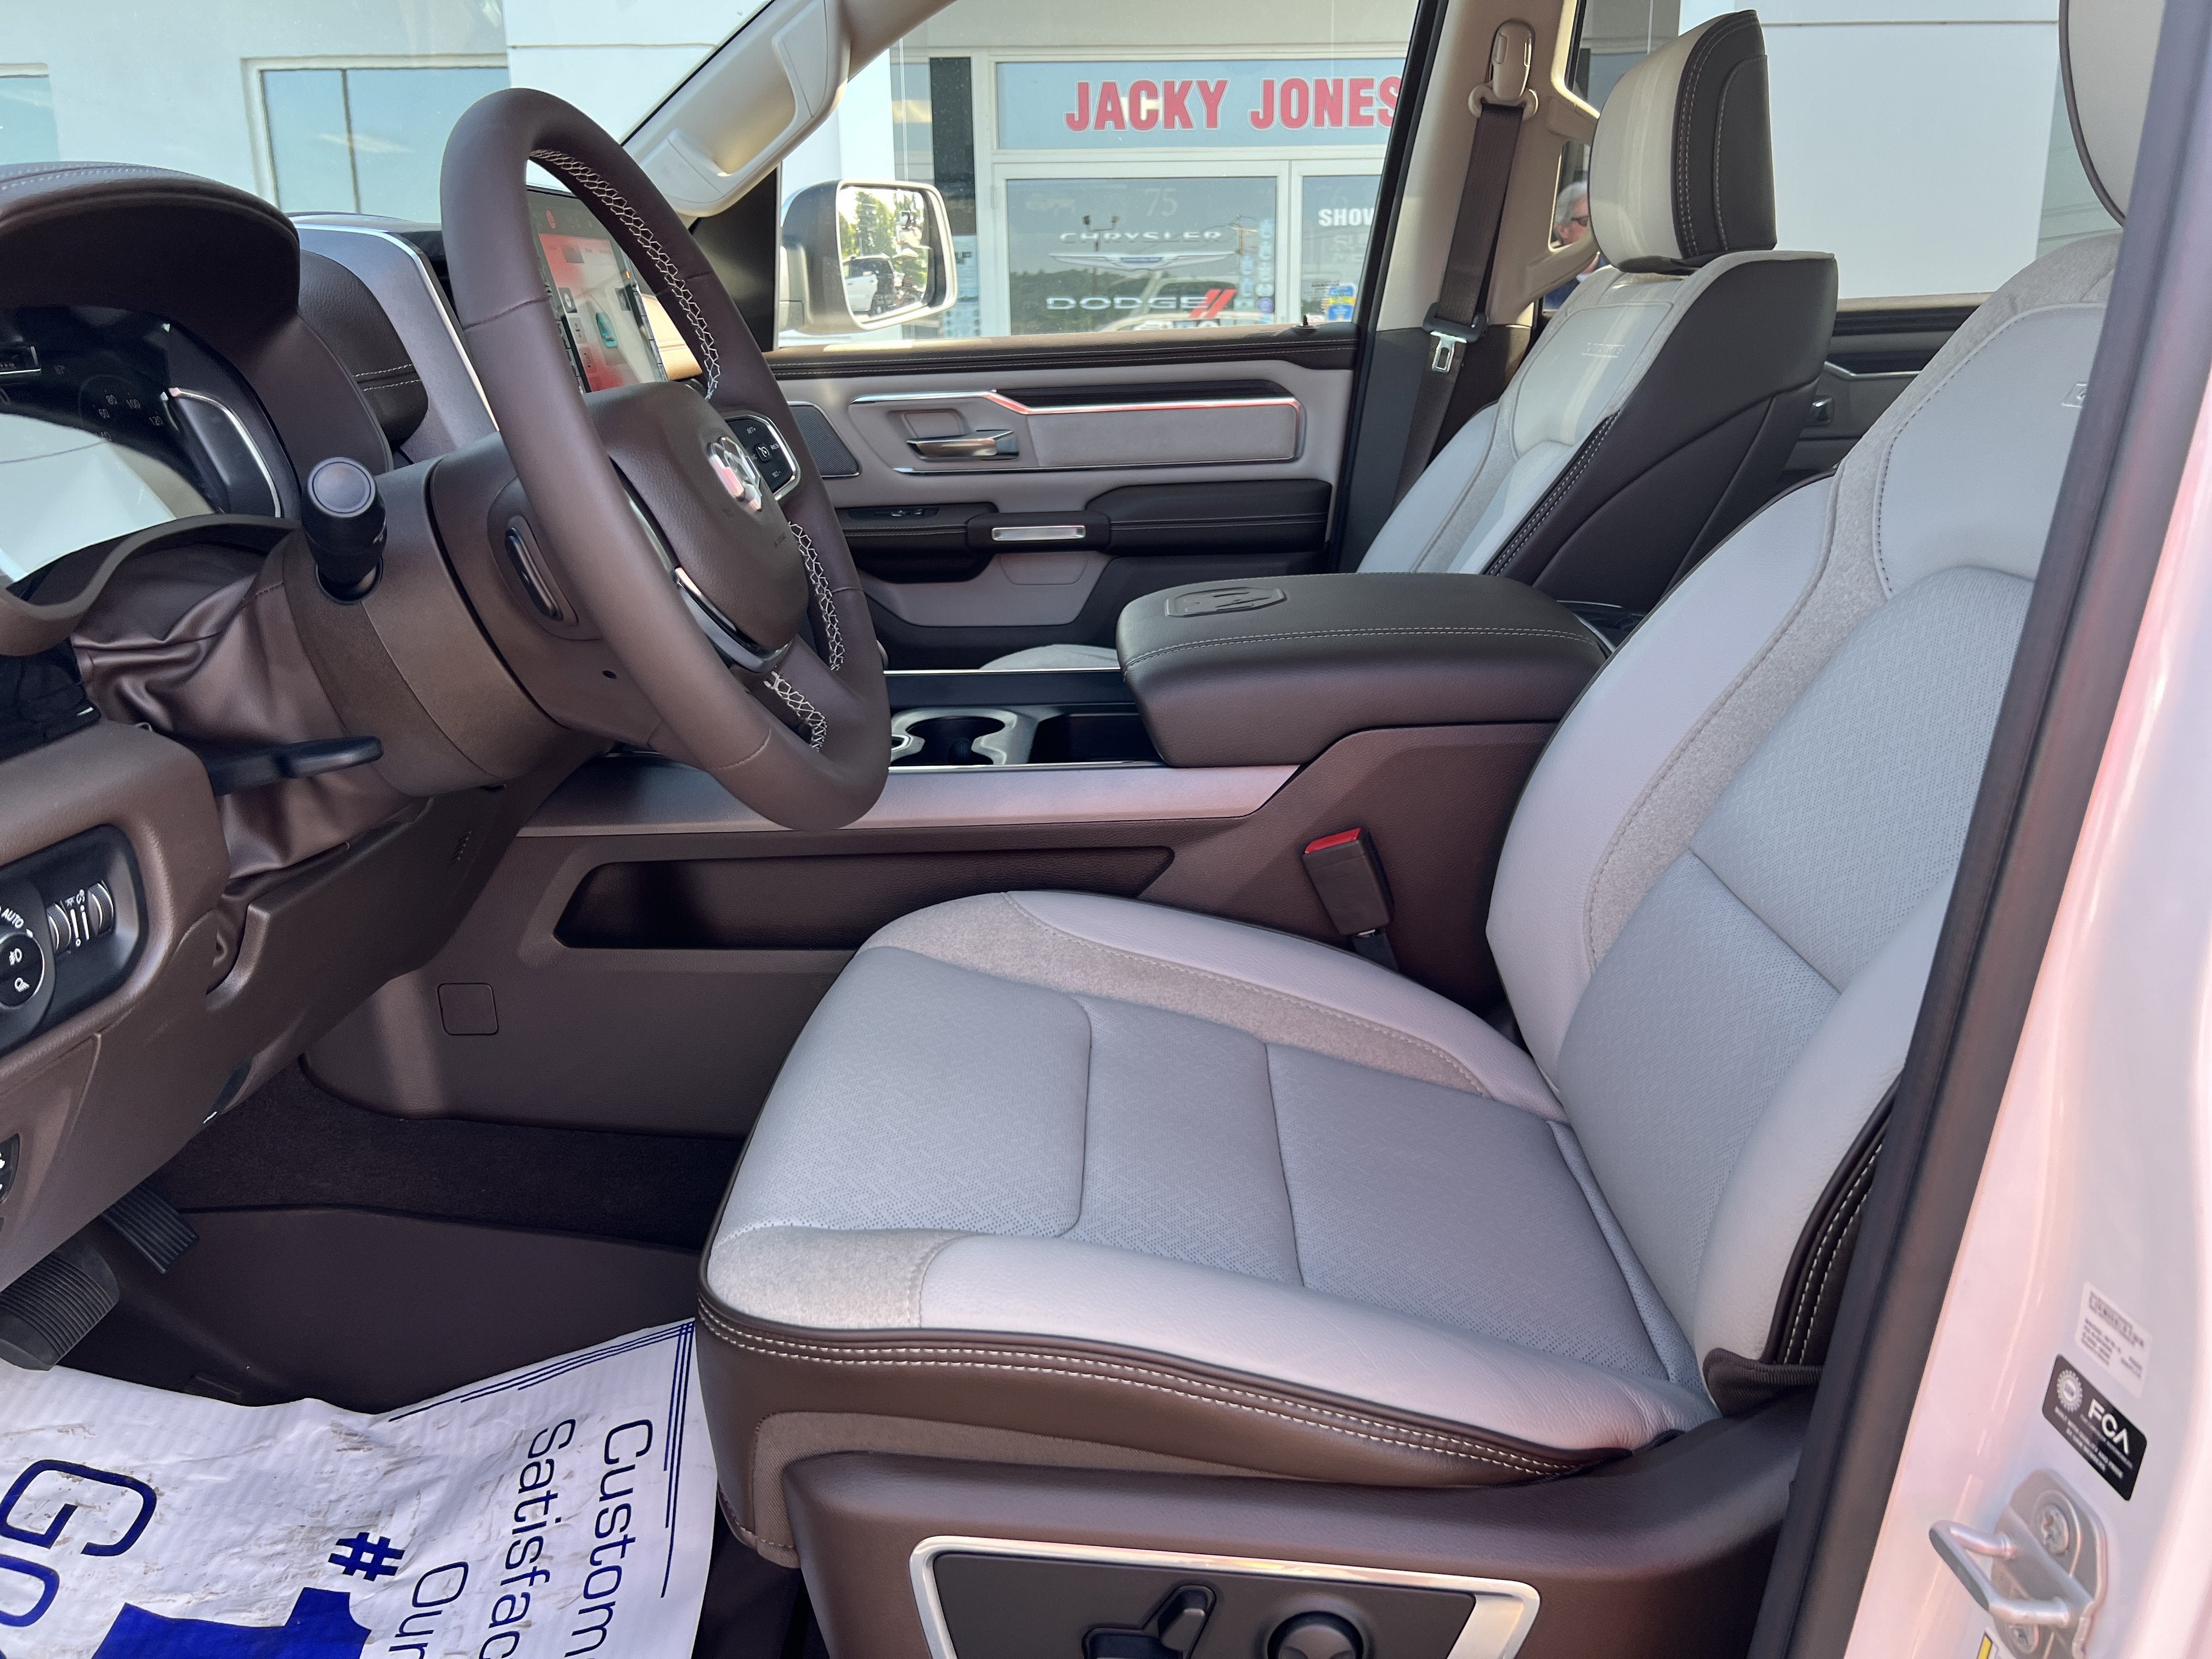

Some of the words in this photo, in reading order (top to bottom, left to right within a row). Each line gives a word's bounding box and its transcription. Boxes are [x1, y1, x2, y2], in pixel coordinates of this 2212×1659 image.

[1064, 78, 1229, 132] JACKY
[1249, 76, 1402, 129] JONES
[1059, 231, 1222, 244] CHRYSLER
[1046, 296, 1208, 311] DODGE
[1, 908, 25, 929] AUTO
[2087, 1398, 2130, 1455] FCA
[564, 1419, 653, 1659] Custom
